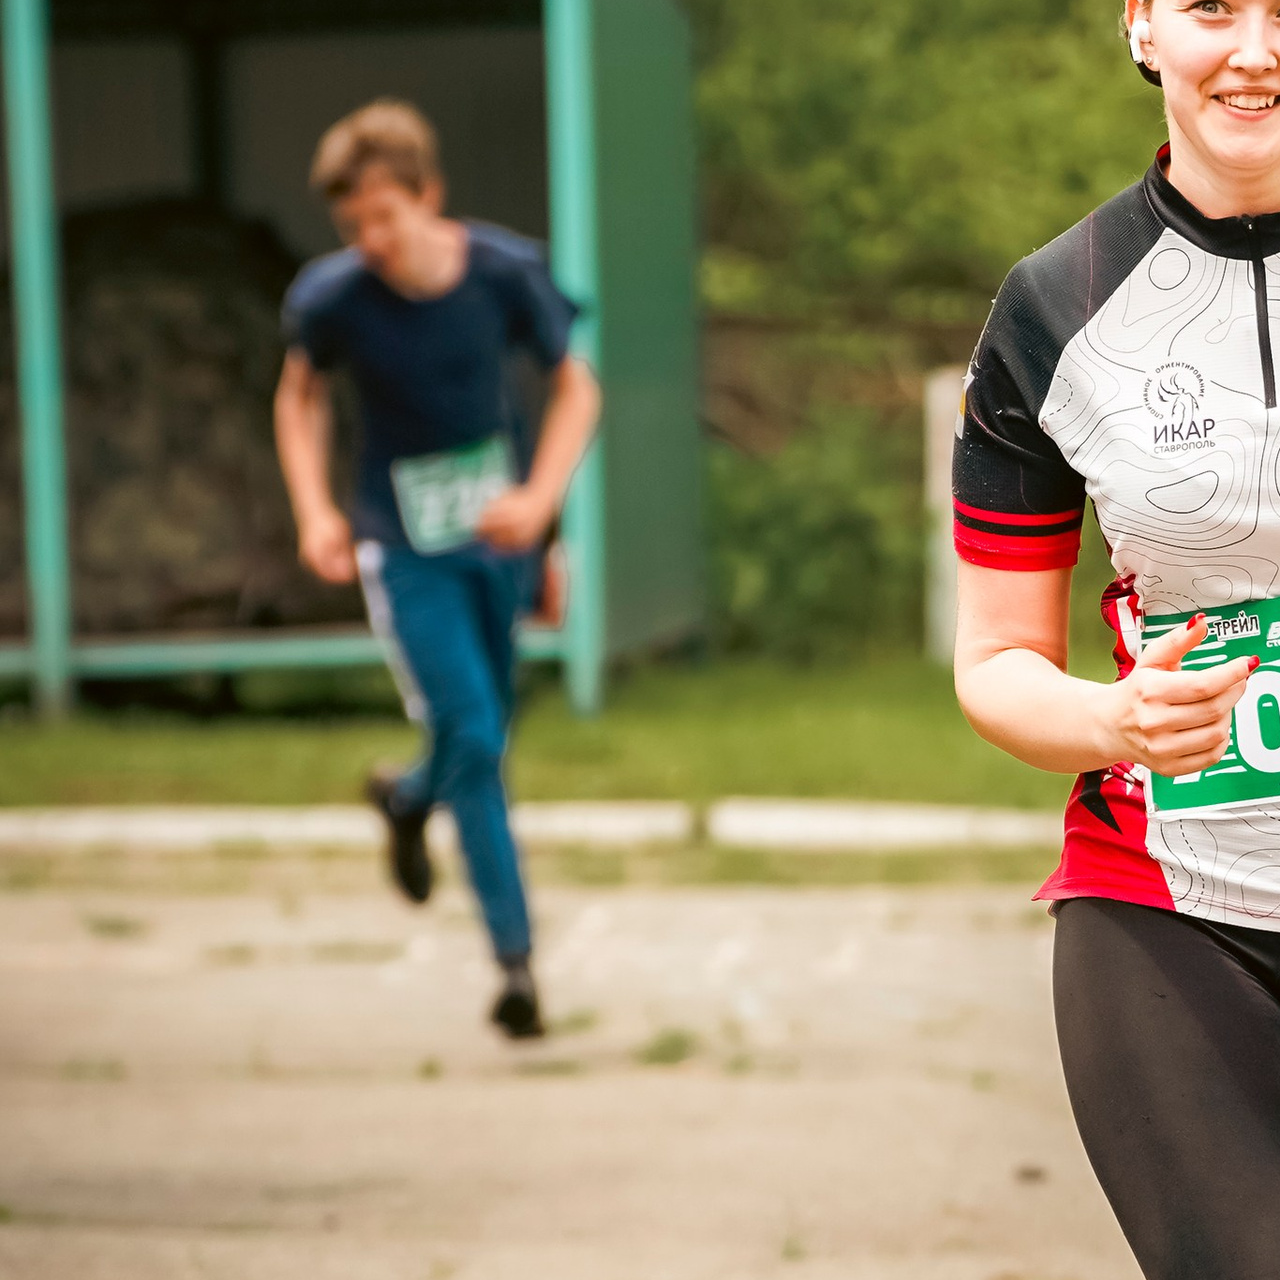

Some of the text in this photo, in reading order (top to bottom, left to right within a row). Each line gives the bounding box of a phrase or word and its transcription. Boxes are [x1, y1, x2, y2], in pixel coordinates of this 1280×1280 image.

[1143, 361, 1205, 420] СПОРТИВНОЕ ОРИЕНТИРОВАНИЕ
[1153, 418, 1216, 444] ИКАР
[1153, 440, 1216, 454] СТАВРОПОЛЬ
[1203, 612, 1259, 639] -ТРЕЙЛ
